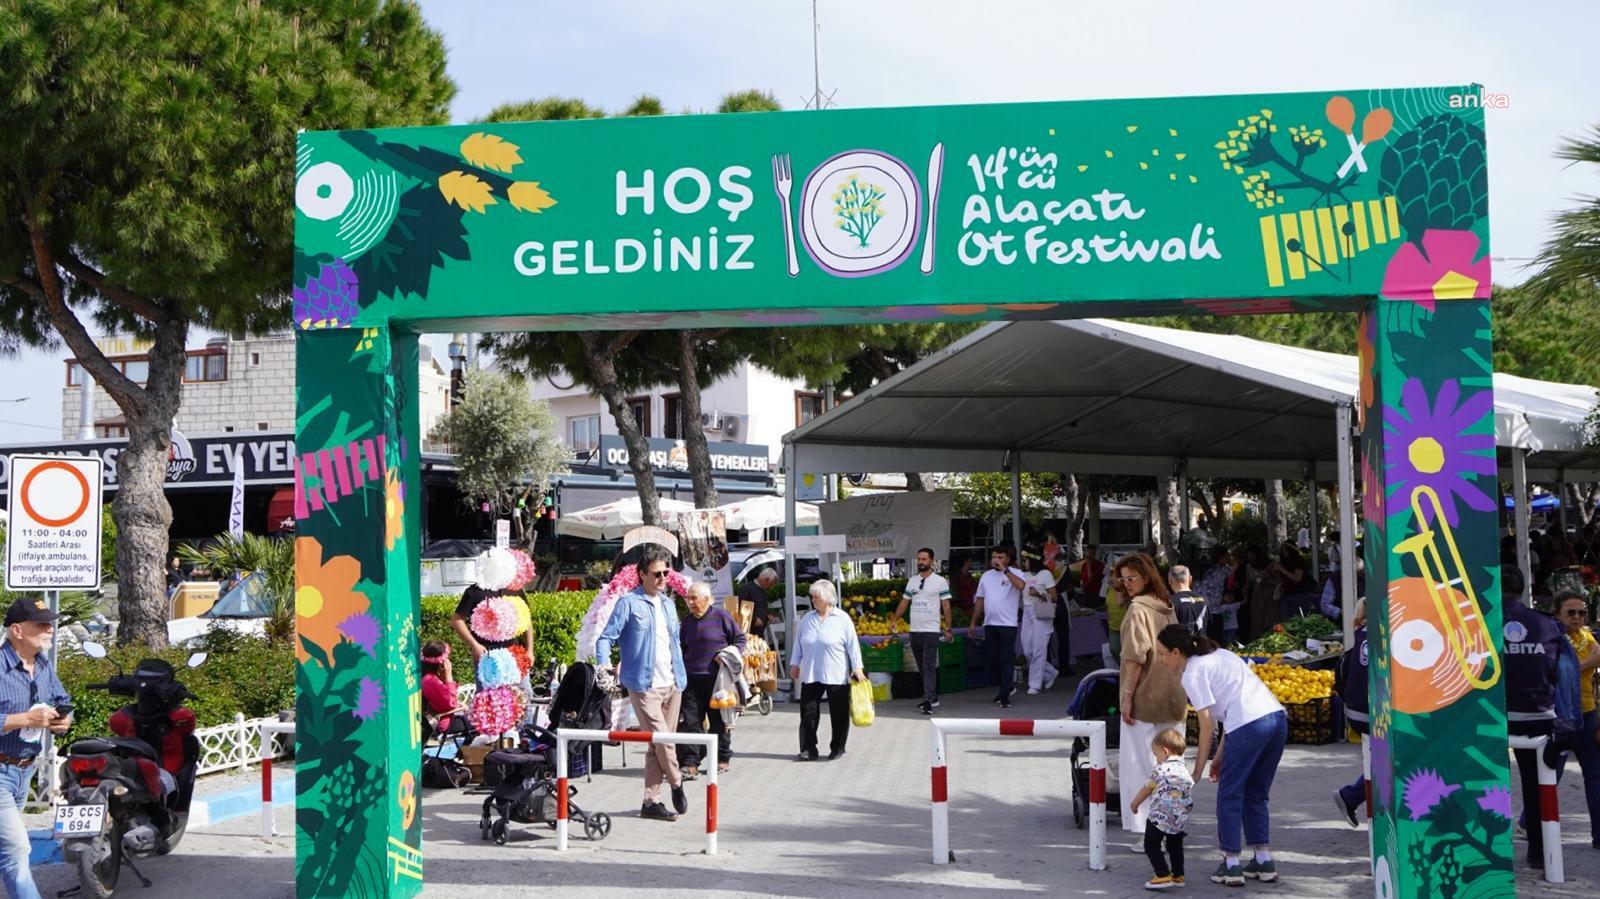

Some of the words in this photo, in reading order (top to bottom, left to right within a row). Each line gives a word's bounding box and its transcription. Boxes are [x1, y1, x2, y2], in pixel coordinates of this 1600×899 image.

[615, 166, 754, 222] HOŞ
[962, 189, 1146, 229] Alaçatı
[513, 226, 755, 276] GELDİNİZ
[957, 230, 1018, 266] Ot
[1024, 223, 1222, 265] Festivali
[206, 442, 244, 474] EV
[22, 529, 49, 537] 11:00
[60, 529, 88, 537] 04:00
[28, 541, 58, 549] Saatleri
[60, 541, 81, 549] Arası
[13, 564, 42, 573] emniyet
[60, 807, 74, 818] 35
[80, 807, 101, 817] CCS
[69, 820, 90, 831] 694
